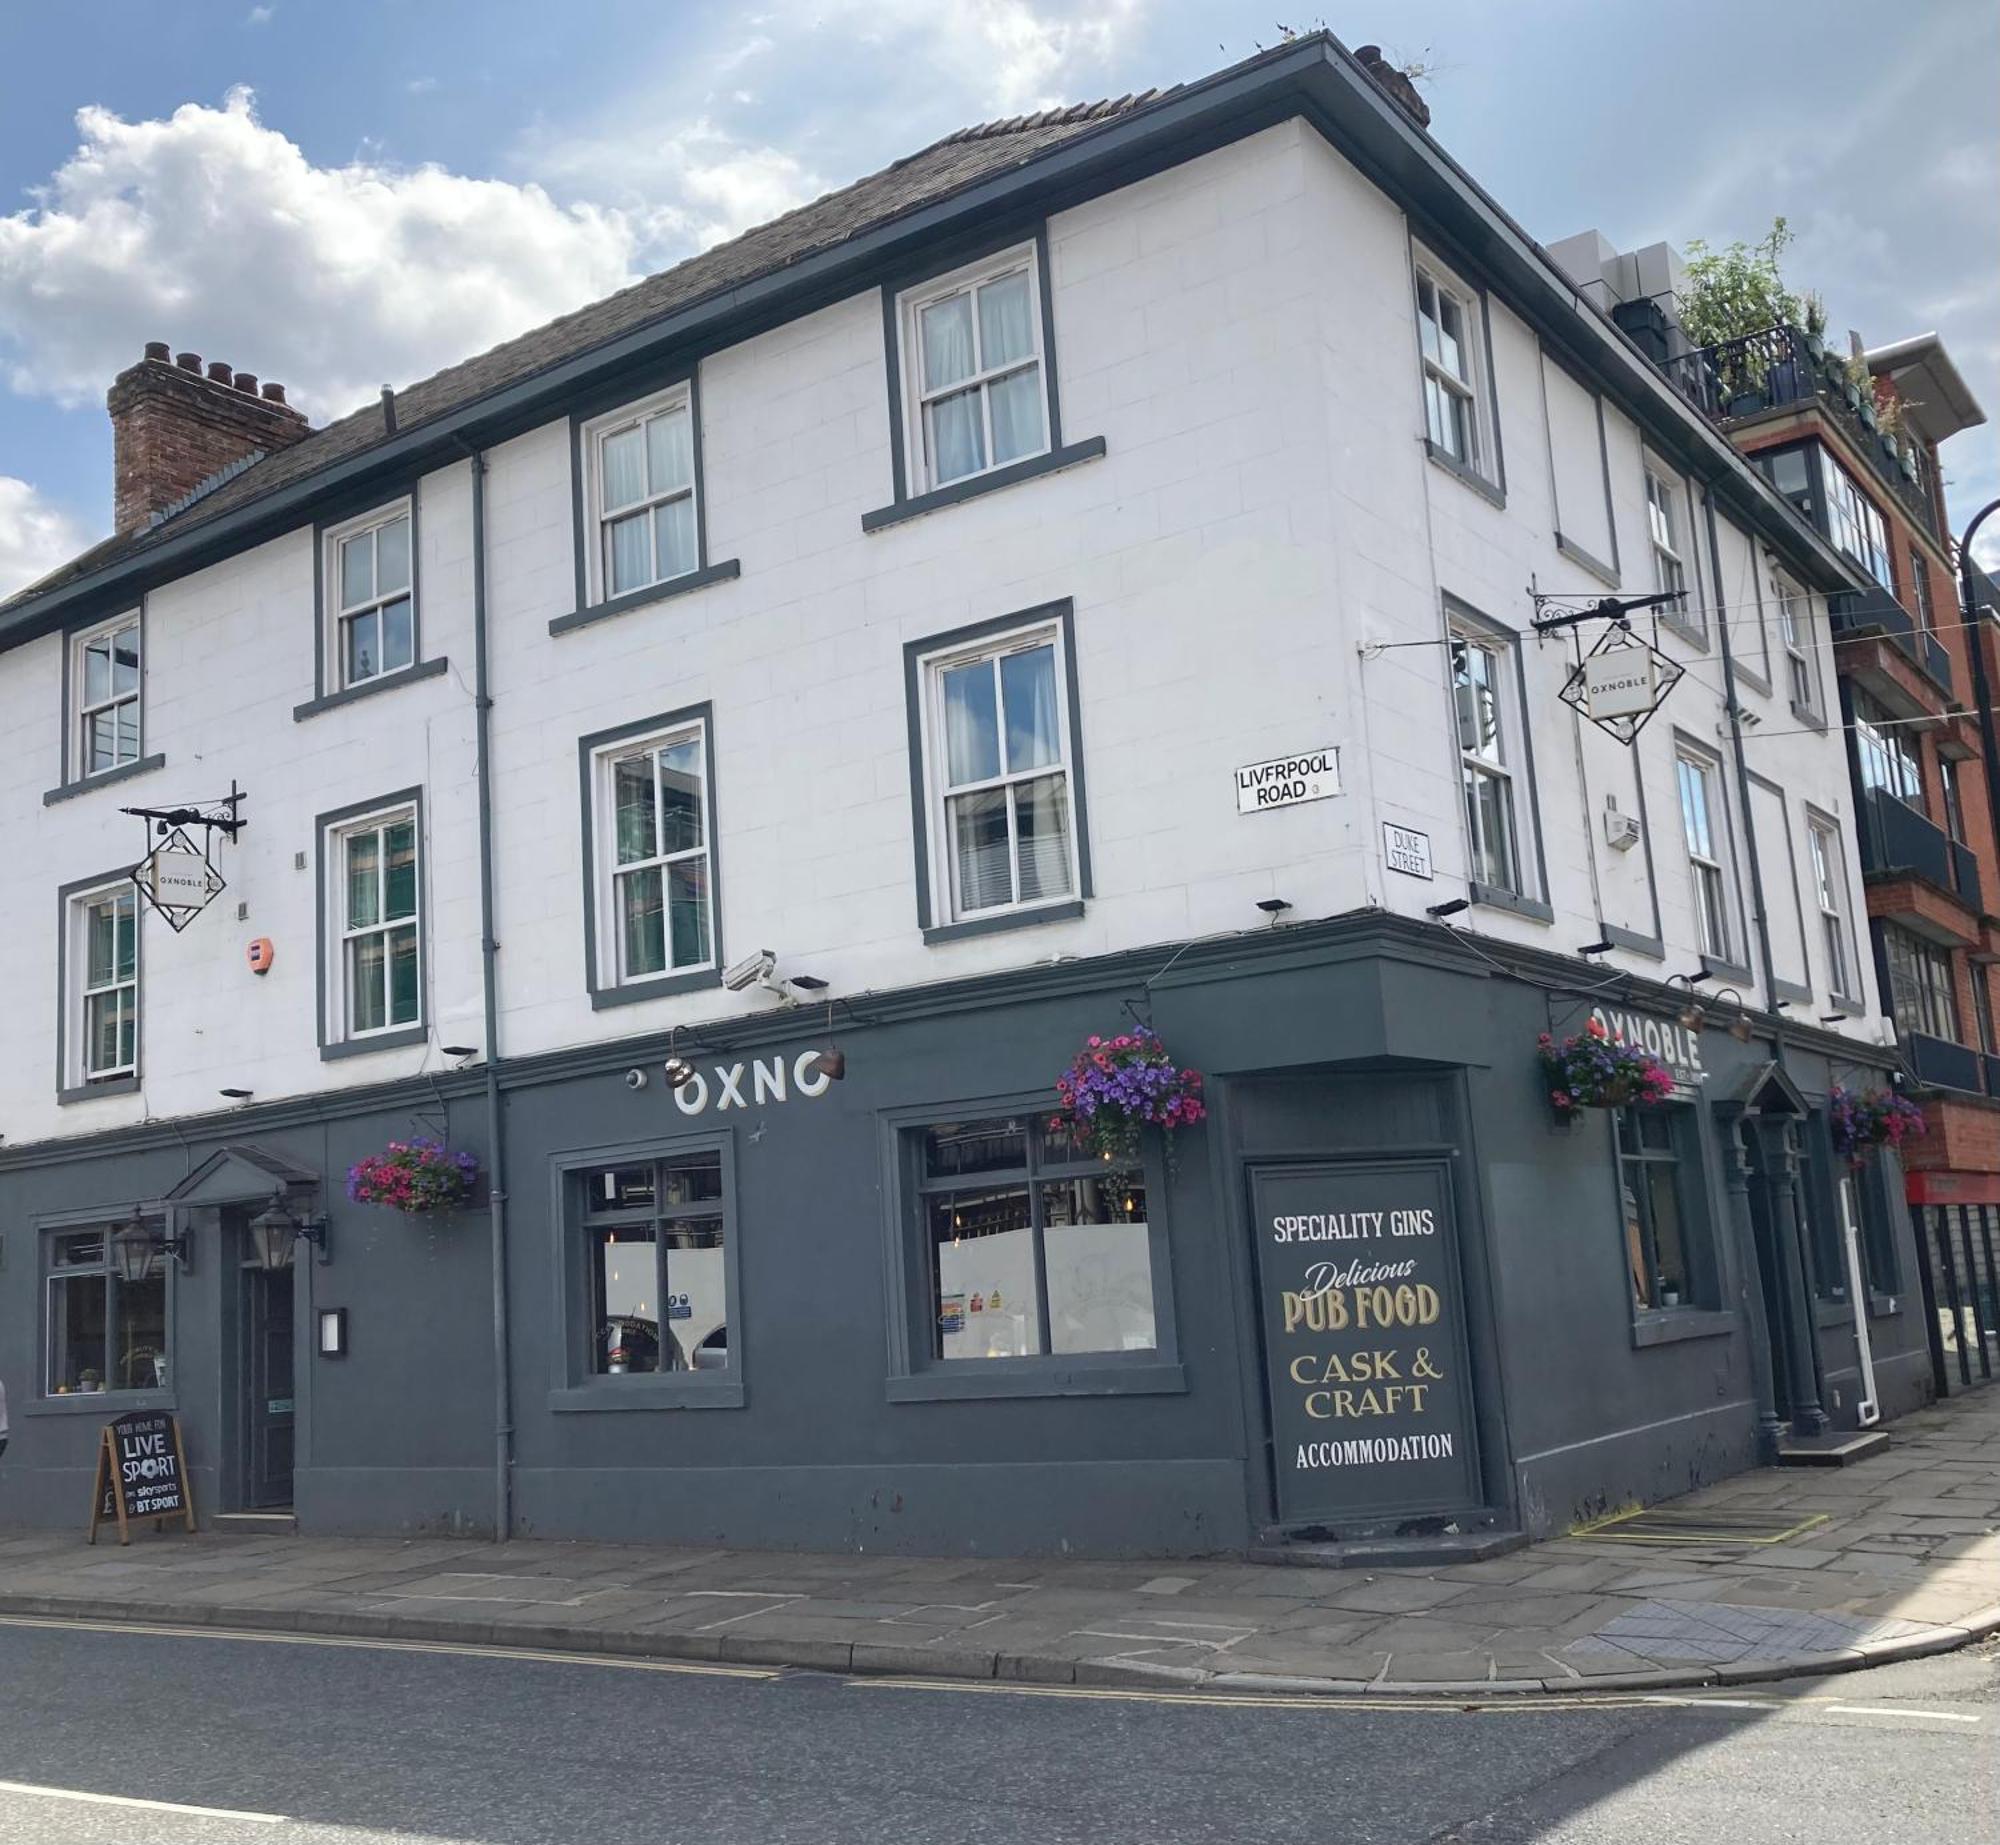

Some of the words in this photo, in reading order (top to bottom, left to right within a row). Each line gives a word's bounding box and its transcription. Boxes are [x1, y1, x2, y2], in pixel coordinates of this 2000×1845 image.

[1591, 676, 1648, 694] OXNOBLE
[1257, 780, 1306, 806] ROAD
[1394, 830, 1420, 853] DUKE
[1391, 850, 1425, 875] STREET
[160, 877, 202, 888] OXNOBLE
[1273, 1211, 1384, 1243] SPECIALITY
[1391, 1208, 1435, 1236] GINS
[1300, 1258, 1417, 1302] Delicious
[1280, 1288, 1350, 1334] PUB
[1354, 1283, 1441, 1329] FOOD
[1289, 1349, 1403, 1385] CASK
[1411, 1346, 1444, 1380] &
[1304, 1384, 1429, 1419] CRAFT
[123, 1433, 167, 1458] LIVE
[1296, 1433, 1453, 1469] ACCOMMODATION
[137, 1499, 151, 1513] BT
[152, 1495, 180, 1510] SPORT
